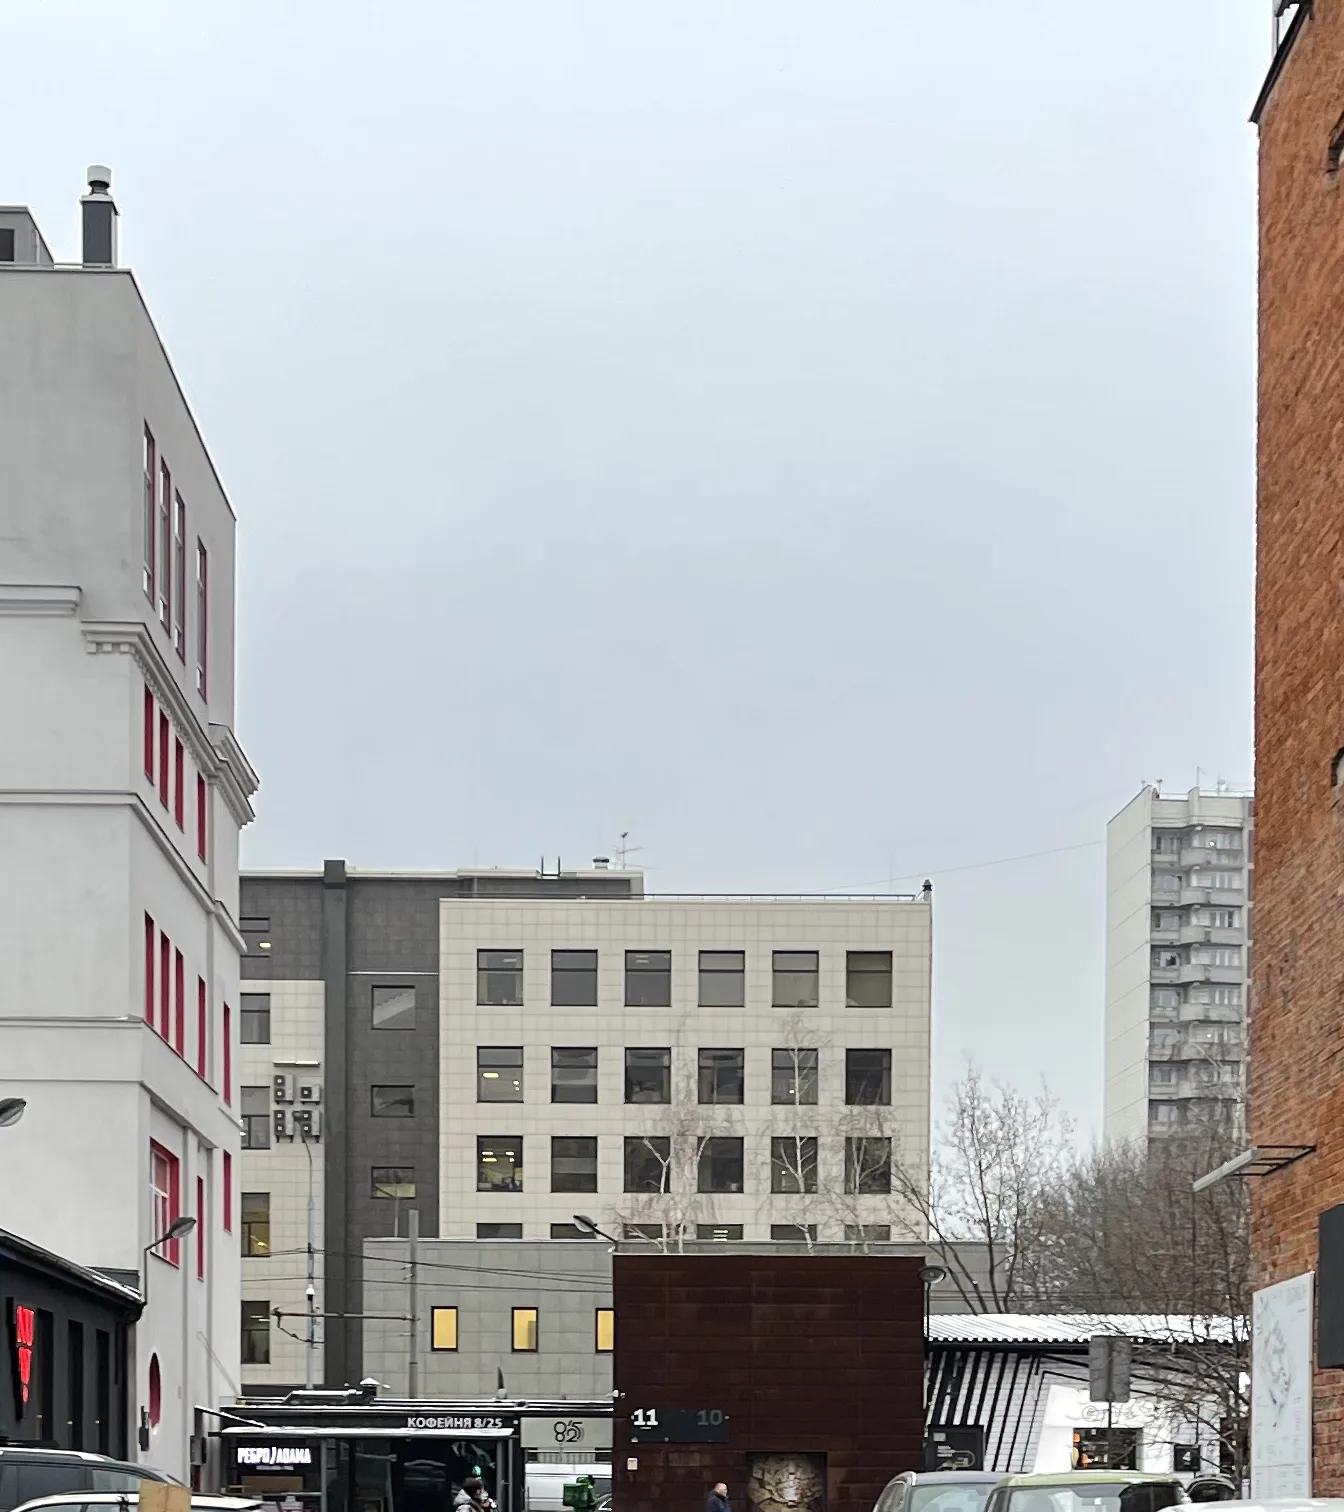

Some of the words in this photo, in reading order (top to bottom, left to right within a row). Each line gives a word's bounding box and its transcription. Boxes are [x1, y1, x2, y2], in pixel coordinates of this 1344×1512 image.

[407, 1416, 472, 1429] КОФЕЙНЯ
[474, 1418, 503, 1429] 8/25
[633, 1408, 658, 1426] 11
[697, 1409, 723, 1426] 10
